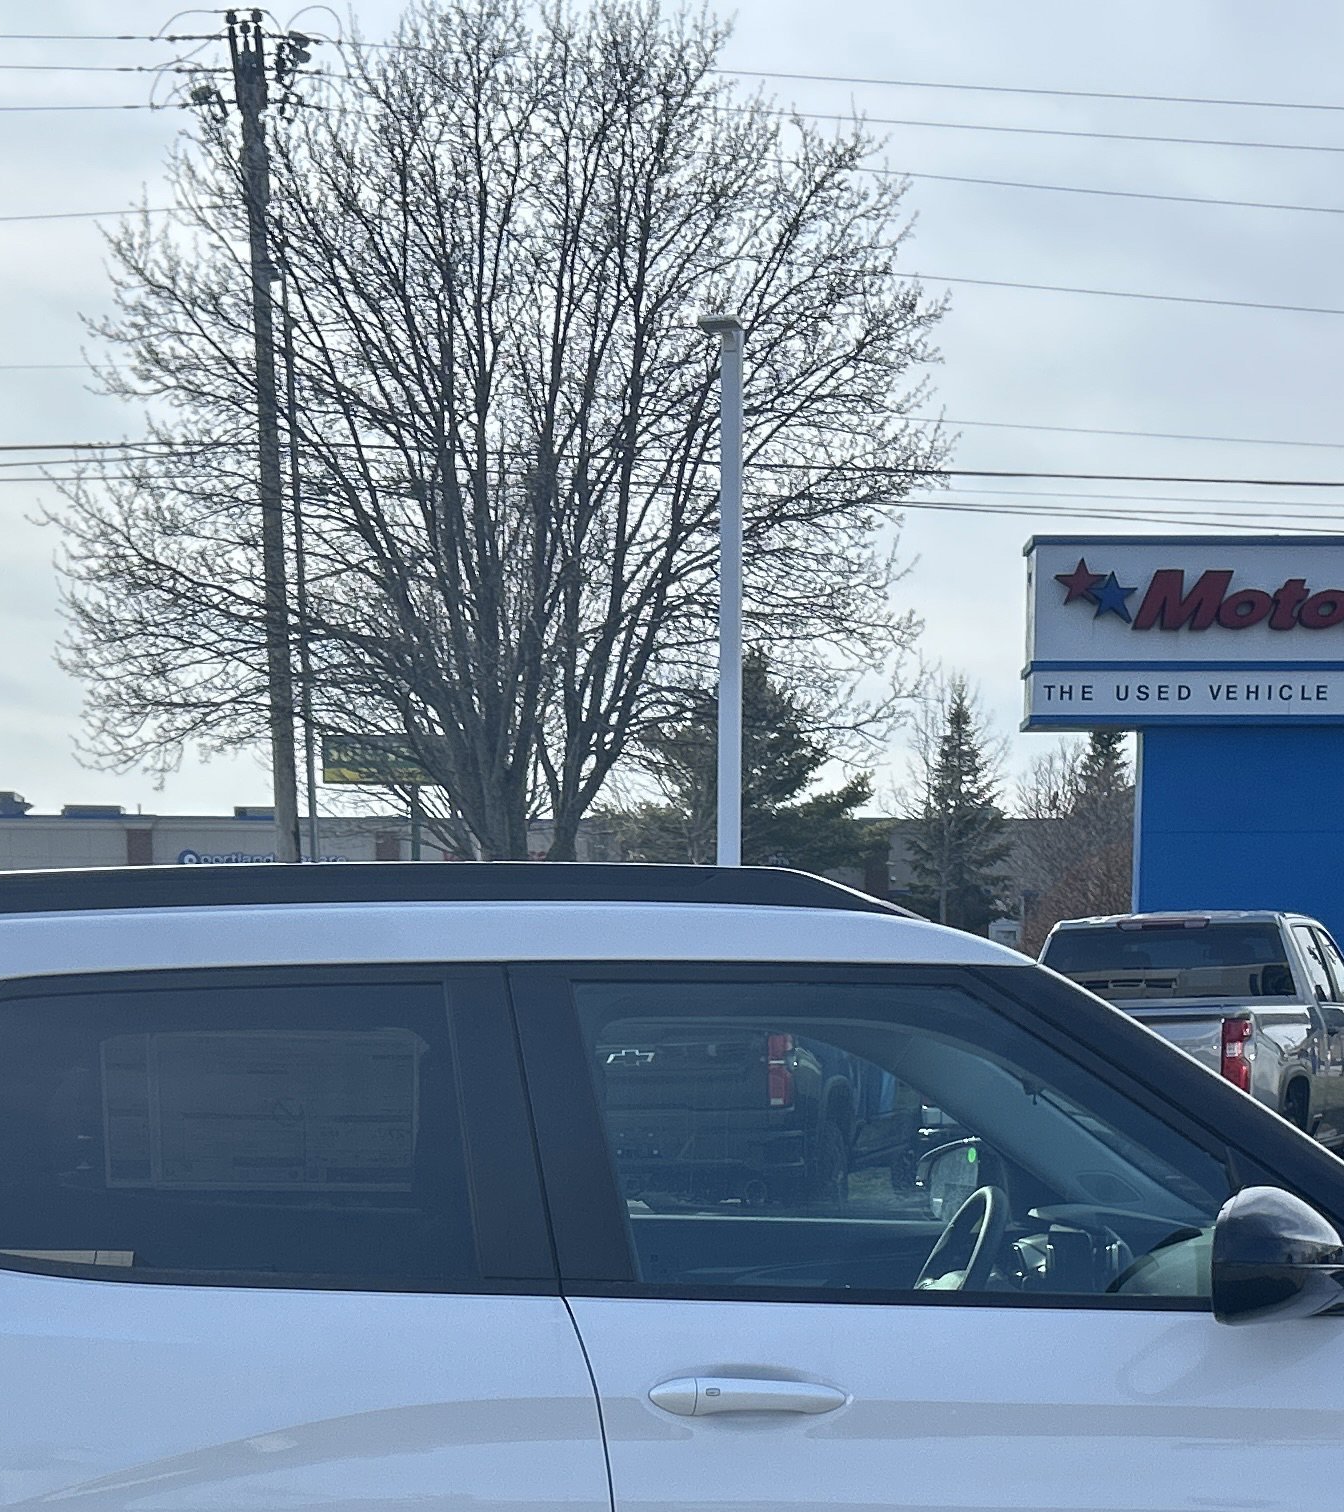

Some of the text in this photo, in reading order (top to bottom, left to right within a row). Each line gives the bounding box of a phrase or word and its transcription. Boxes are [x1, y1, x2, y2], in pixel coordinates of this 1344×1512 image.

[1044, 684, 1094, 701] THE
[1116, 684, 1192, 701] USED
[1209, 684, 1328, 701] VEHICLE
